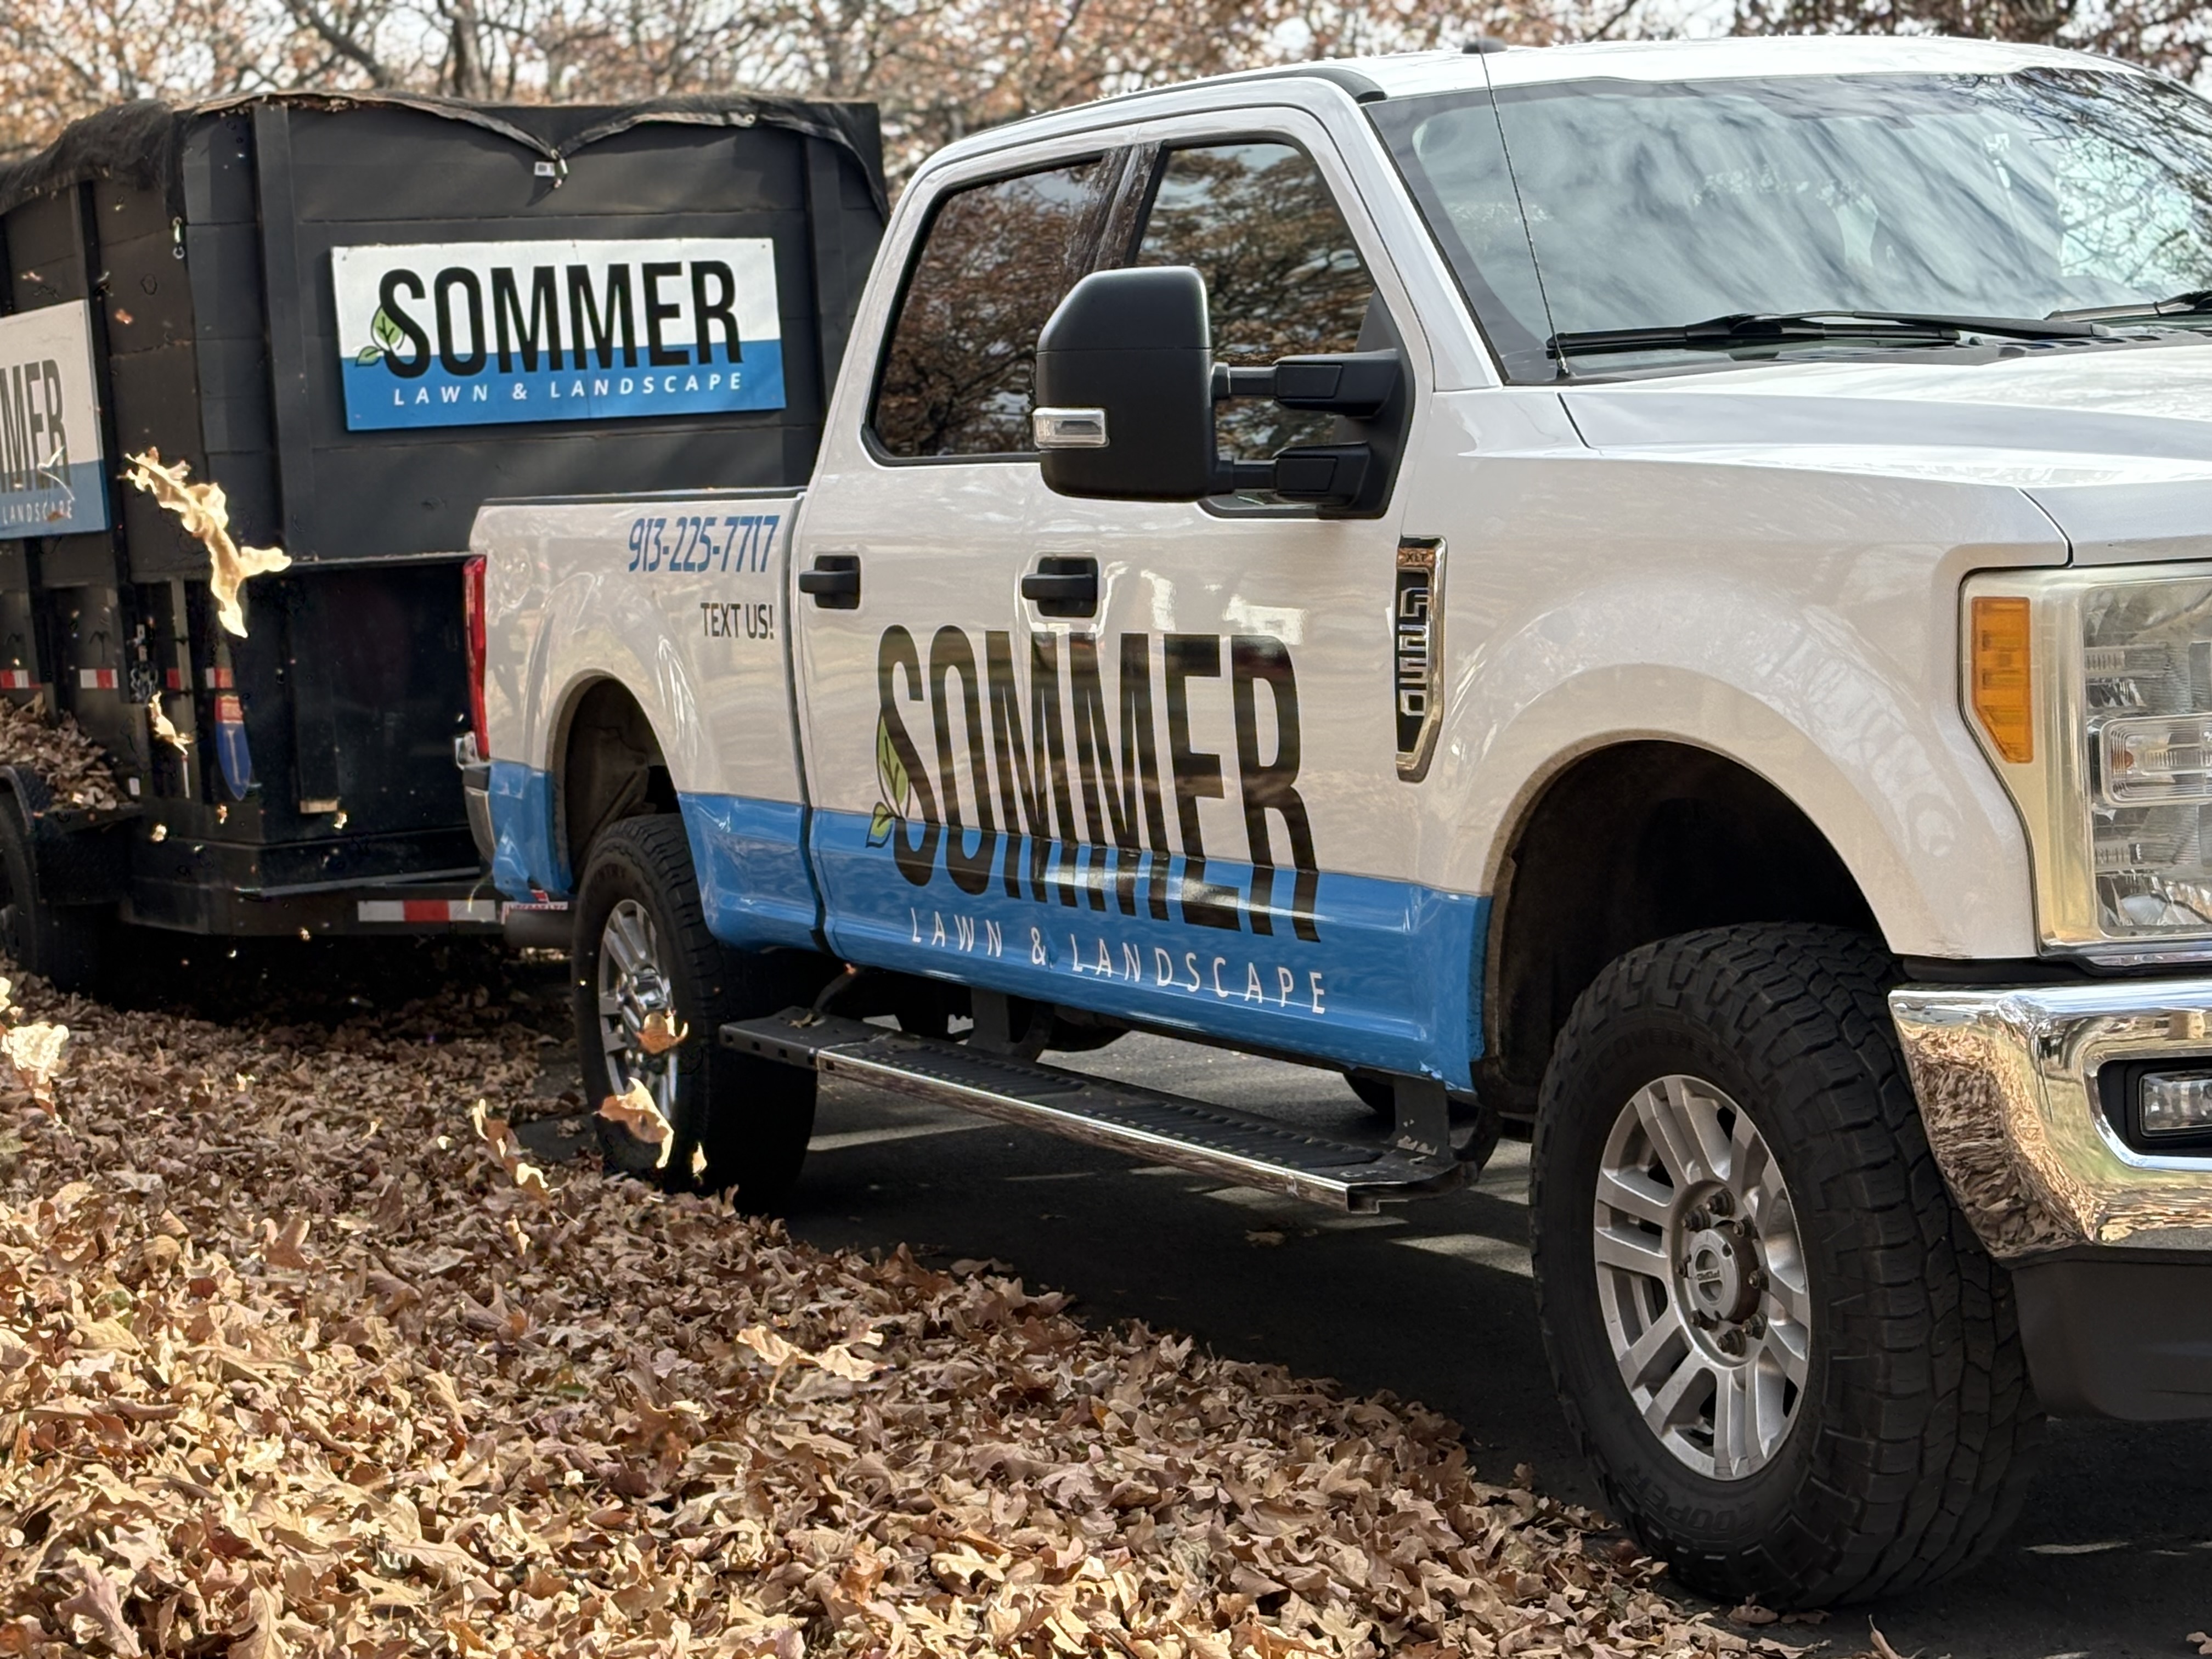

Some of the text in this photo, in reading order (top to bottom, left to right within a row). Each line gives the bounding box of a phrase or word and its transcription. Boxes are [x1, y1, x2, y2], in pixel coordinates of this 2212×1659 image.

[378, 260, 744, 379] SOMMER
[394, 372, 742, 406] LAWN & LANDSCAPE
[628, 515, 780, 572] 913-225-7717
[1406, 552, 1427, 562] XLT
[700, 602, 774, 640] TEXT US!
[877, 624, 1321, 943] SOMMER
[910, 907, 1326, 1014] LAWN & LANDSCAPE
